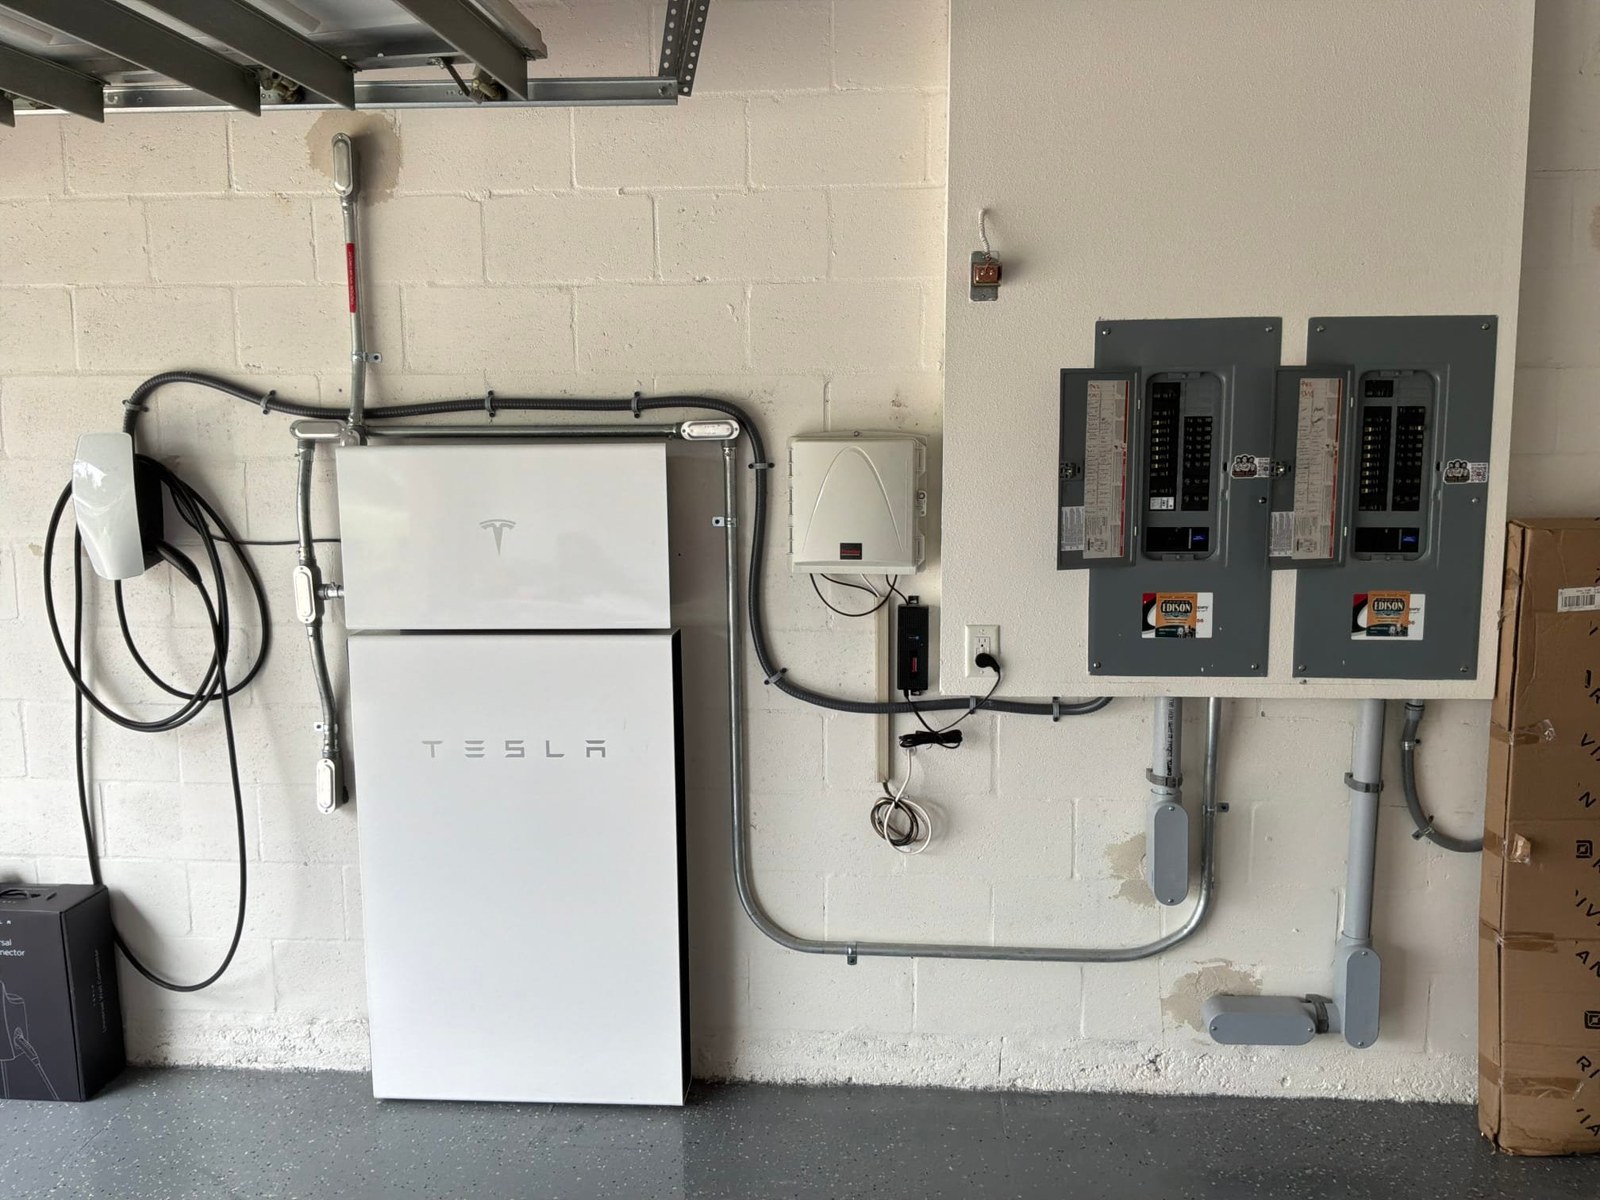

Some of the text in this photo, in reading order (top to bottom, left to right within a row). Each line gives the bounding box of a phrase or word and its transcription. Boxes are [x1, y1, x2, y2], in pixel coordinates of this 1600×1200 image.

[1162, 603, 1191, 612] EDISON
[1374, 601, 1404, 610] EDISON
[421, 739, 606, 758] TESLA
